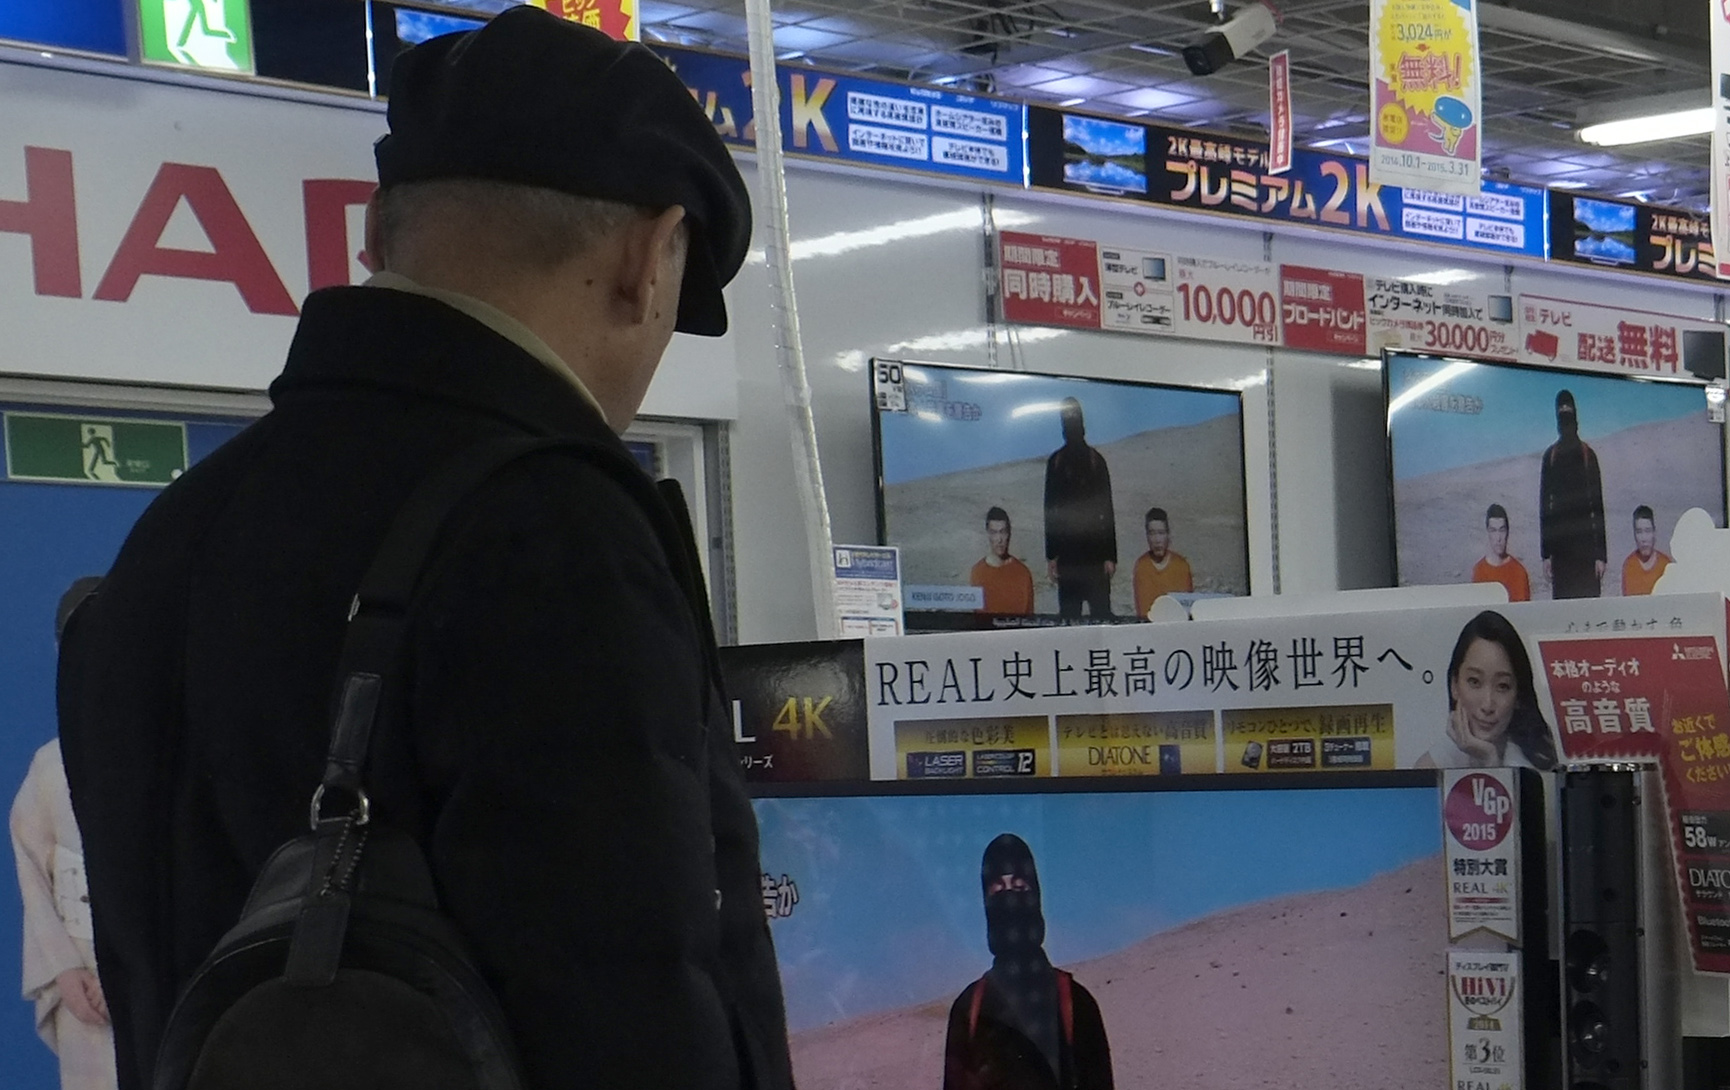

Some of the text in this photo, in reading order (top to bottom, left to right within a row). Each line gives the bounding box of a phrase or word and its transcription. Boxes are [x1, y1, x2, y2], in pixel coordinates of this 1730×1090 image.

[1166, 160, 1391, 231] プレミアム2K
[1004, 268, 1098, 307] 同時購入
[1176, 283, 1276, 328] 10,000
[1282, 302, 1365, 331] ブロードバンド
[1539, 308, 1572, 327] テレビ
[1577, 320, 1679, 374] 配送無料
[877, 364, 902, 385] 50
[1550, 657, 1640, 679] 本格オーディオ
[1581, 680, 1621, 694] のような
[772, 695, 834, 742] 4K
[1559, 697, 1656, 735] 高音質
[1671, 713, 1717, 735] お近くで
[926, 725, 1015, 746] 圧倒的な色彩美
[1088, 745, 1152, 767] DIATONE
[1292, 741, 1313, 755] 2TB
[924, 754, 964, 767] LASER
[1018, 752, 1034, 773] 12
[1471, 778, 1511, 824] VGP
[1462, 823, 1497, 842] 2015
[1453, 858, 1509, 877] 特別大賞
[1453, 881, 1488, 895] REAL
[1461, 976, 1507, 997] HiVi
[1464, 1037, 1506, 1064] 第3位
